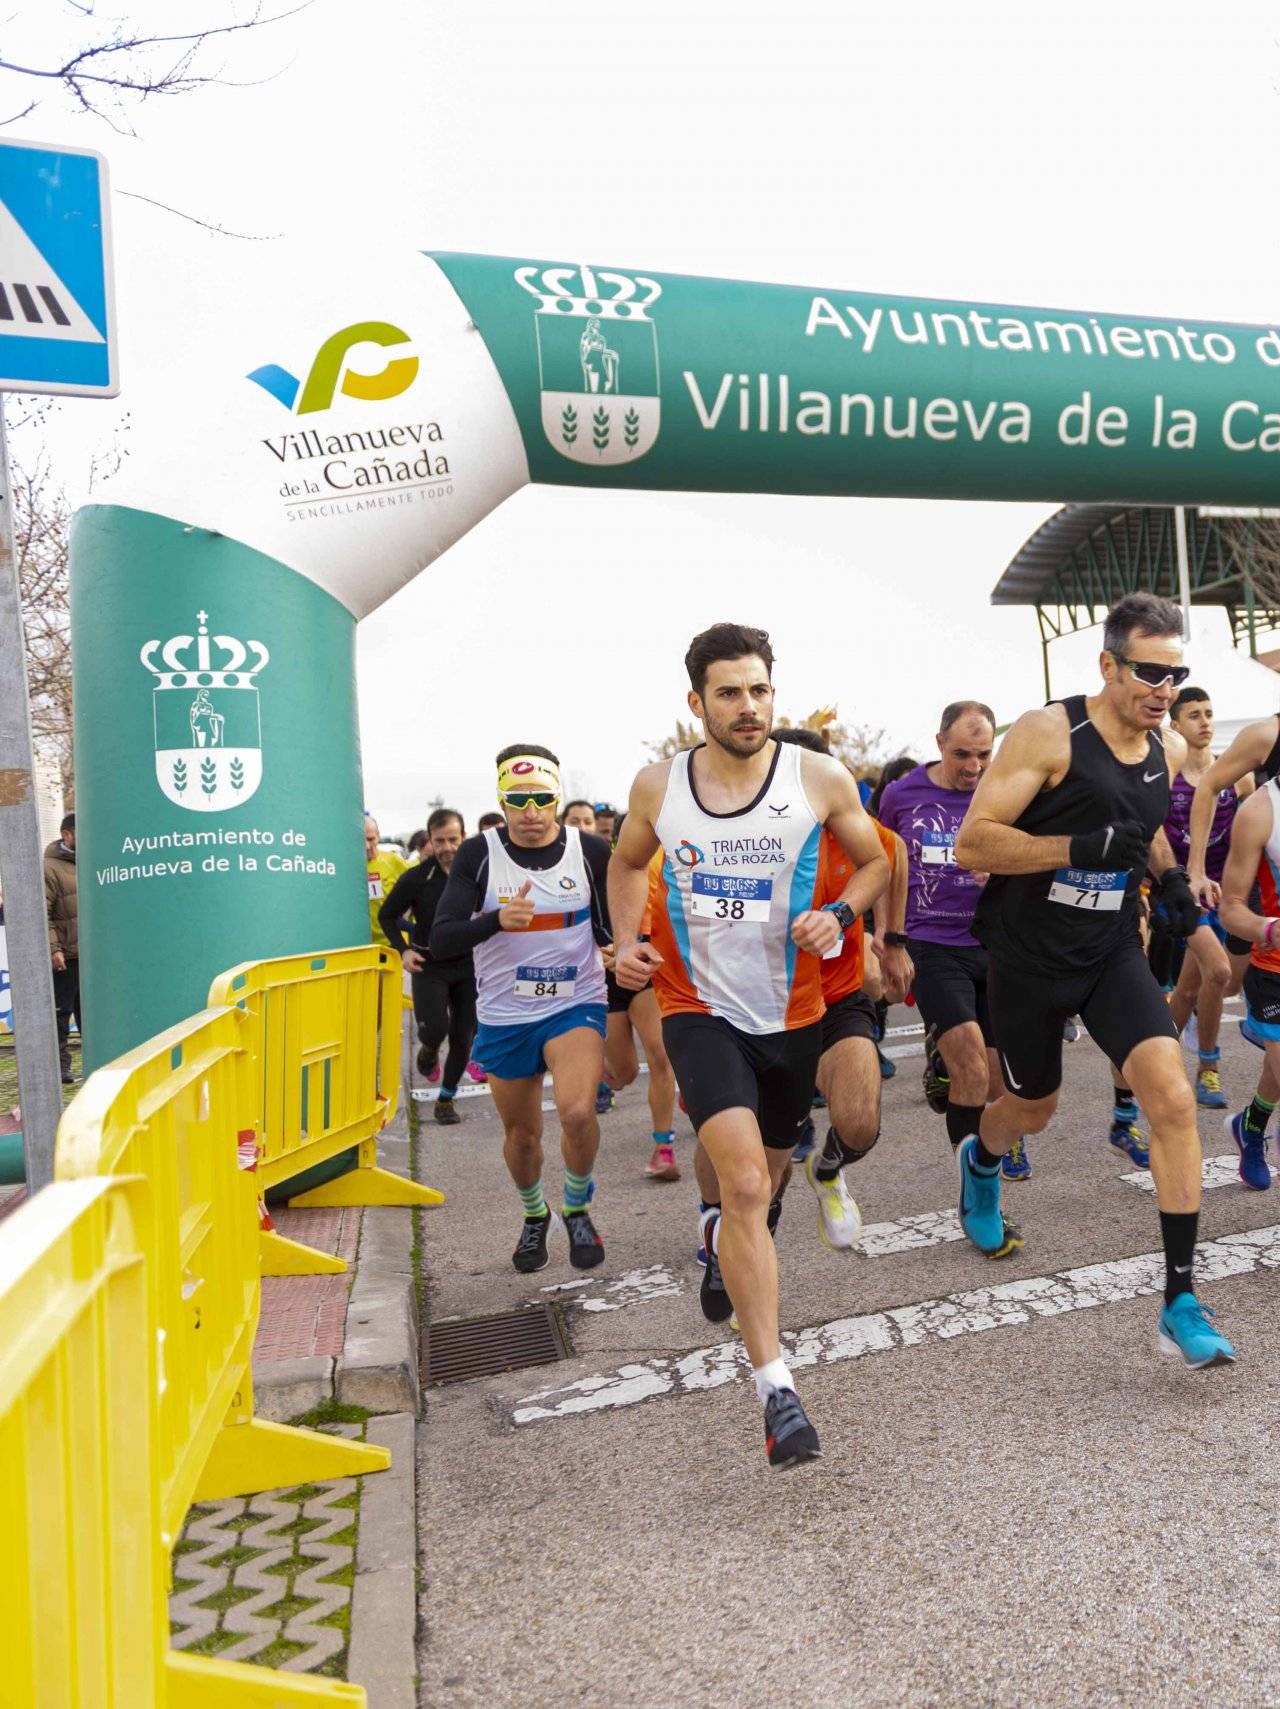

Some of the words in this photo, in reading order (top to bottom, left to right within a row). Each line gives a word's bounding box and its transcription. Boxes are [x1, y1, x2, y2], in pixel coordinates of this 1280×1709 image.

[805, 297, 1237, 365] Ayuntamiento
[683, 371, 1031, 444] Villanueva
[1058, 391, 1129, 446] de
[1152, 395, 1198, 449] la
[261, 421, 444, 463] Villanueva
[279, 482, 301, 498] de
[304, 479, 320, 495] la
[323, 449, 450, 490] Cañada
[287, 493, 413, 522] SENCILLAMENTE
[421, 486, 455, 501] TODO
[121, 829, 275, 855] Ayuntamiento
[282, 829, 306, 847] de
[711, 836, 782, 853] TRIATLÓN
[96, 859, 193, 886] Villanueva
[202, 854, 230, 873] de
[239, 854, 258, 872] la
[266, 855, 336, 876] Cañada
[714, 855, 738, 867] LAS
[742, 854, 786, 864] ROZAS
[715, 899, 745, 919] 38
[1075, 889, 1100, 908] 71
[535, 982, 558, 997] 84
